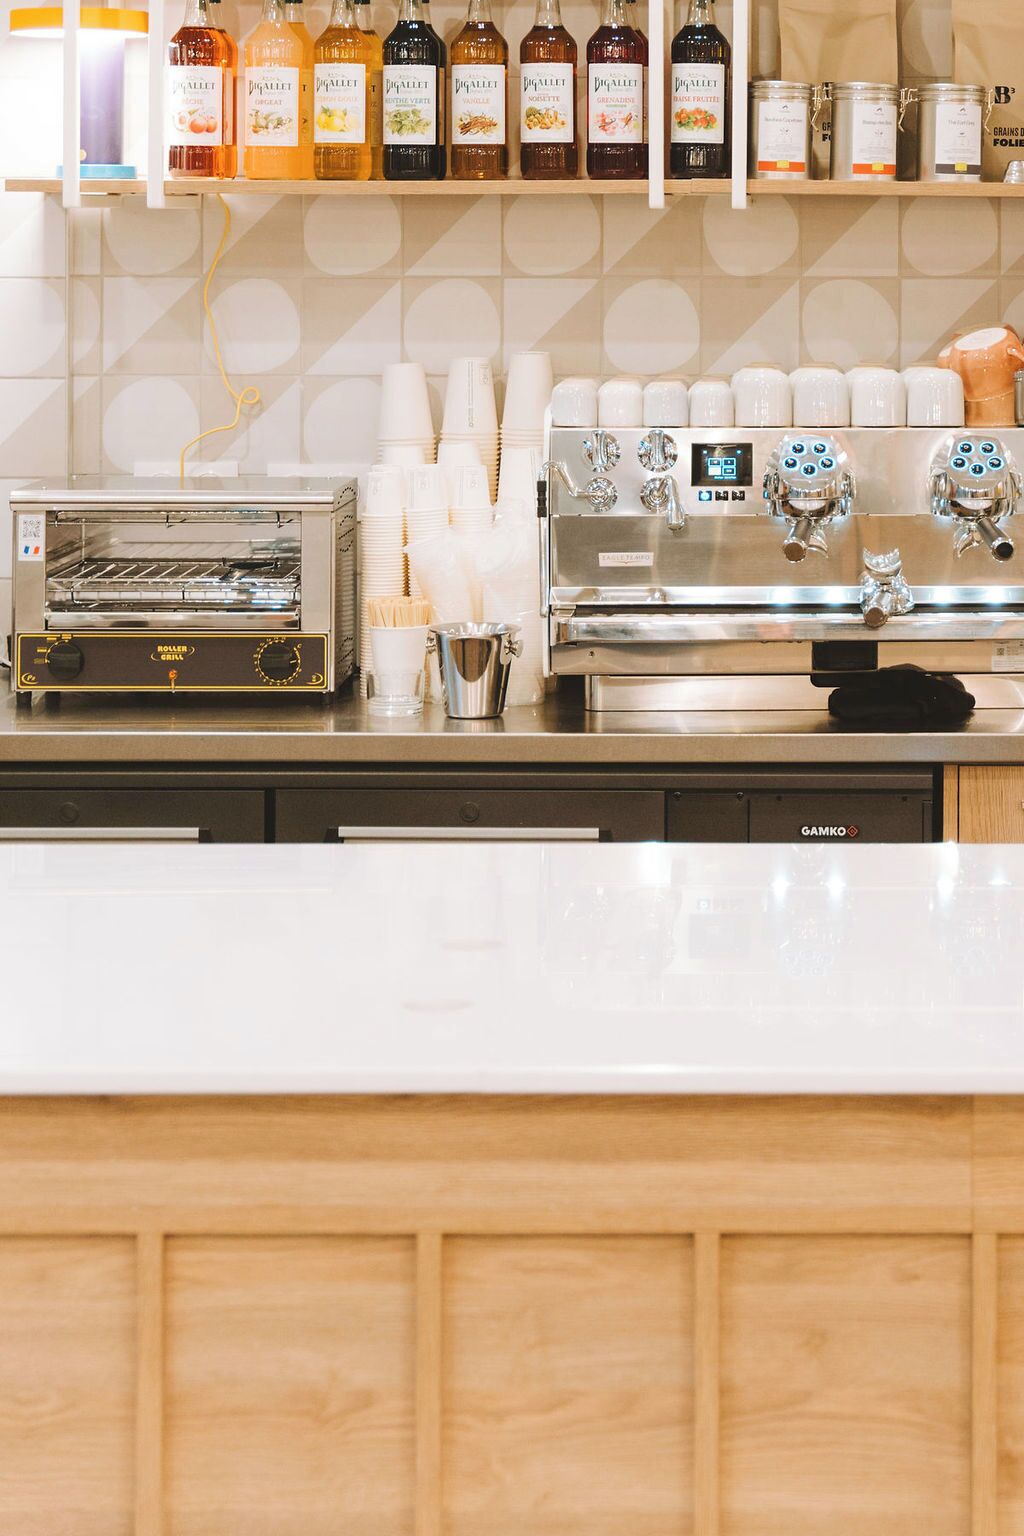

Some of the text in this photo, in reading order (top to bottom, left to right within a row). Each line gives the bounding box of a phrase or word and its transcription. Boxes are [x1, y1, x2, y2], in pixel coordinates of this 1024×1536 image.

[249, 80, 292, 96] BIGALLET
[317, 77, 358, 93] BIGALLET
[386, 79, 429, 94] BIGALLET
[455, 78, 498, 94] BIGALLET
[523, 76, 566, 92] BIGALLET
[594, 76, 638, 93] BIGALLET
[675, 76, 718, 93] BIGALLET
[993, 127, 1019, 137] GRAINS
[801, 826, 846, 836] GAMKO
